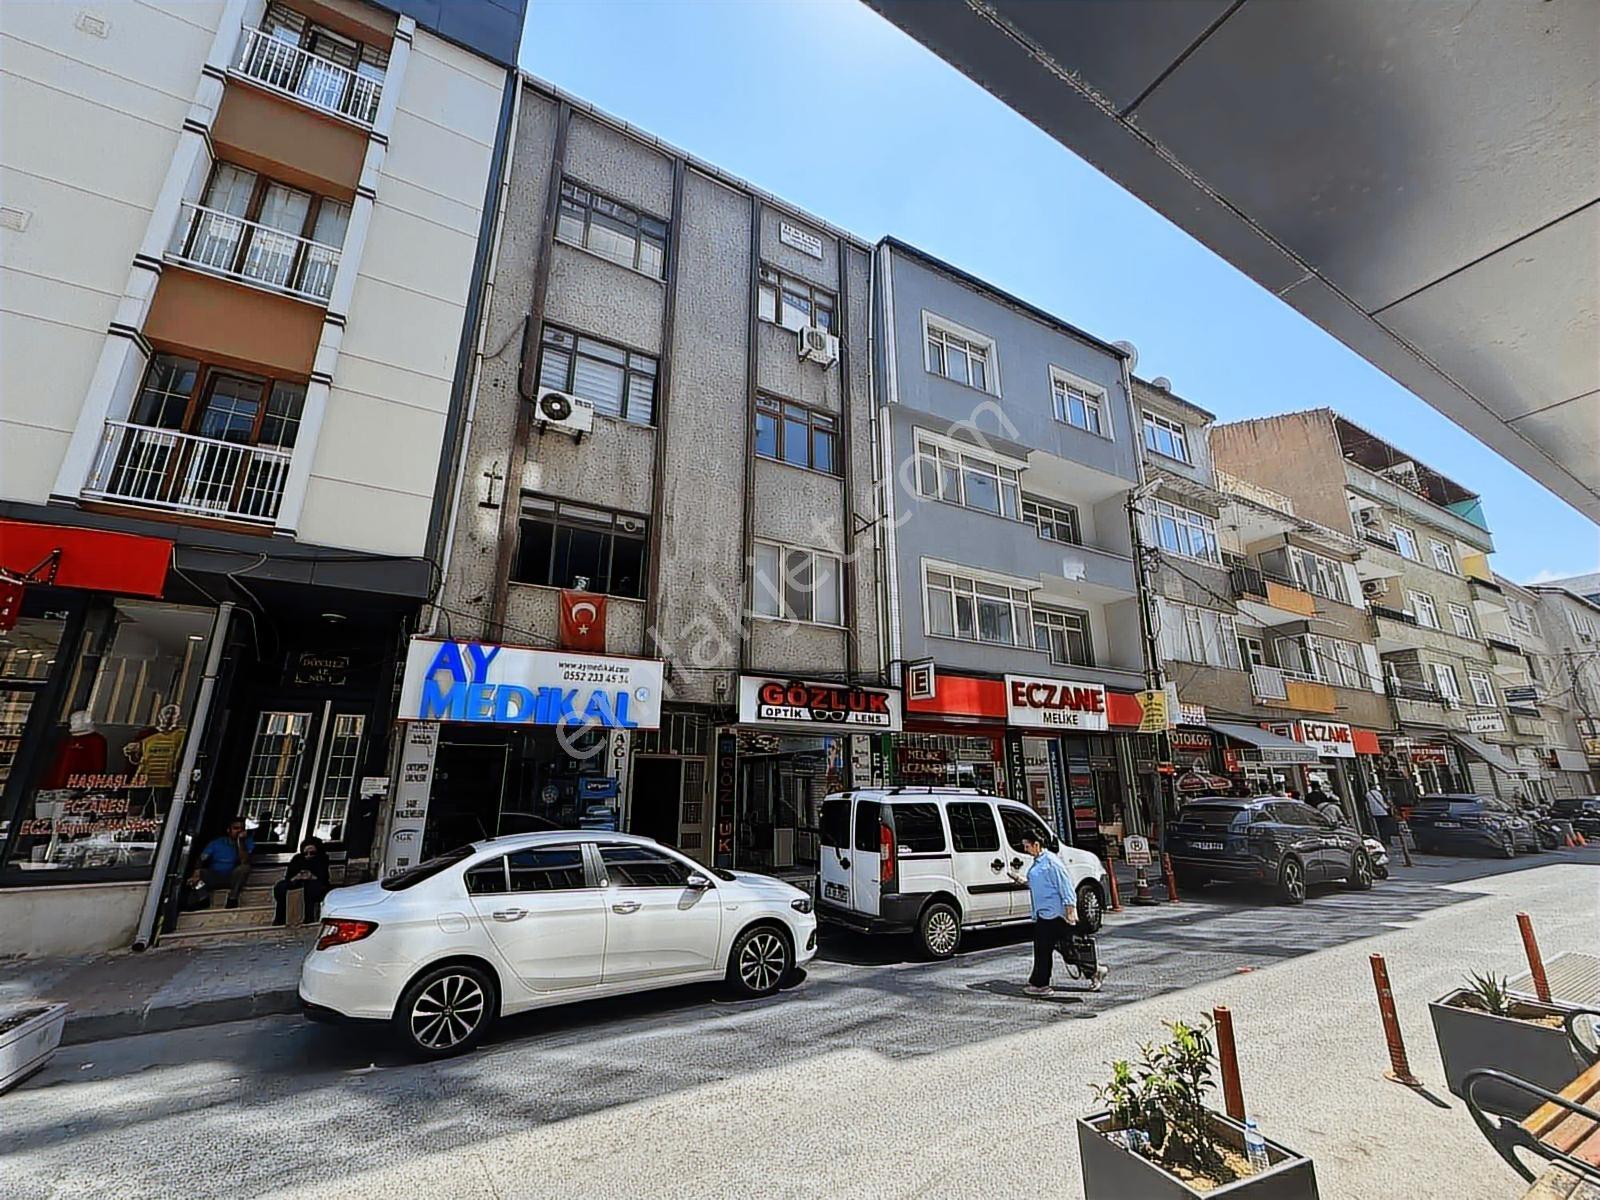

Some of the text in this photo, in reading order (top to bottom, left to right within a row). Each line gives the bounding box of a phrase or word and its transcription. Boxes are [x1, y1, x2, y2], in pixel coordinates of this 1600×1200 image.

[424, 640, 500, 684] AY
[563, 671, 586, 681] 0552
[419, 682, 638, 729] MEDİKAL
[760, 681, 890, 713] GÖZLÜK
[1011, 682, 1105, 713] ECZANE
[765, 707, 802, 718] OPTİK
[855, 713, 882, 723] LENS
[1043, 711, 1079, 725] MELİKE
[1305, 723, 1351, 743] ECZANE
